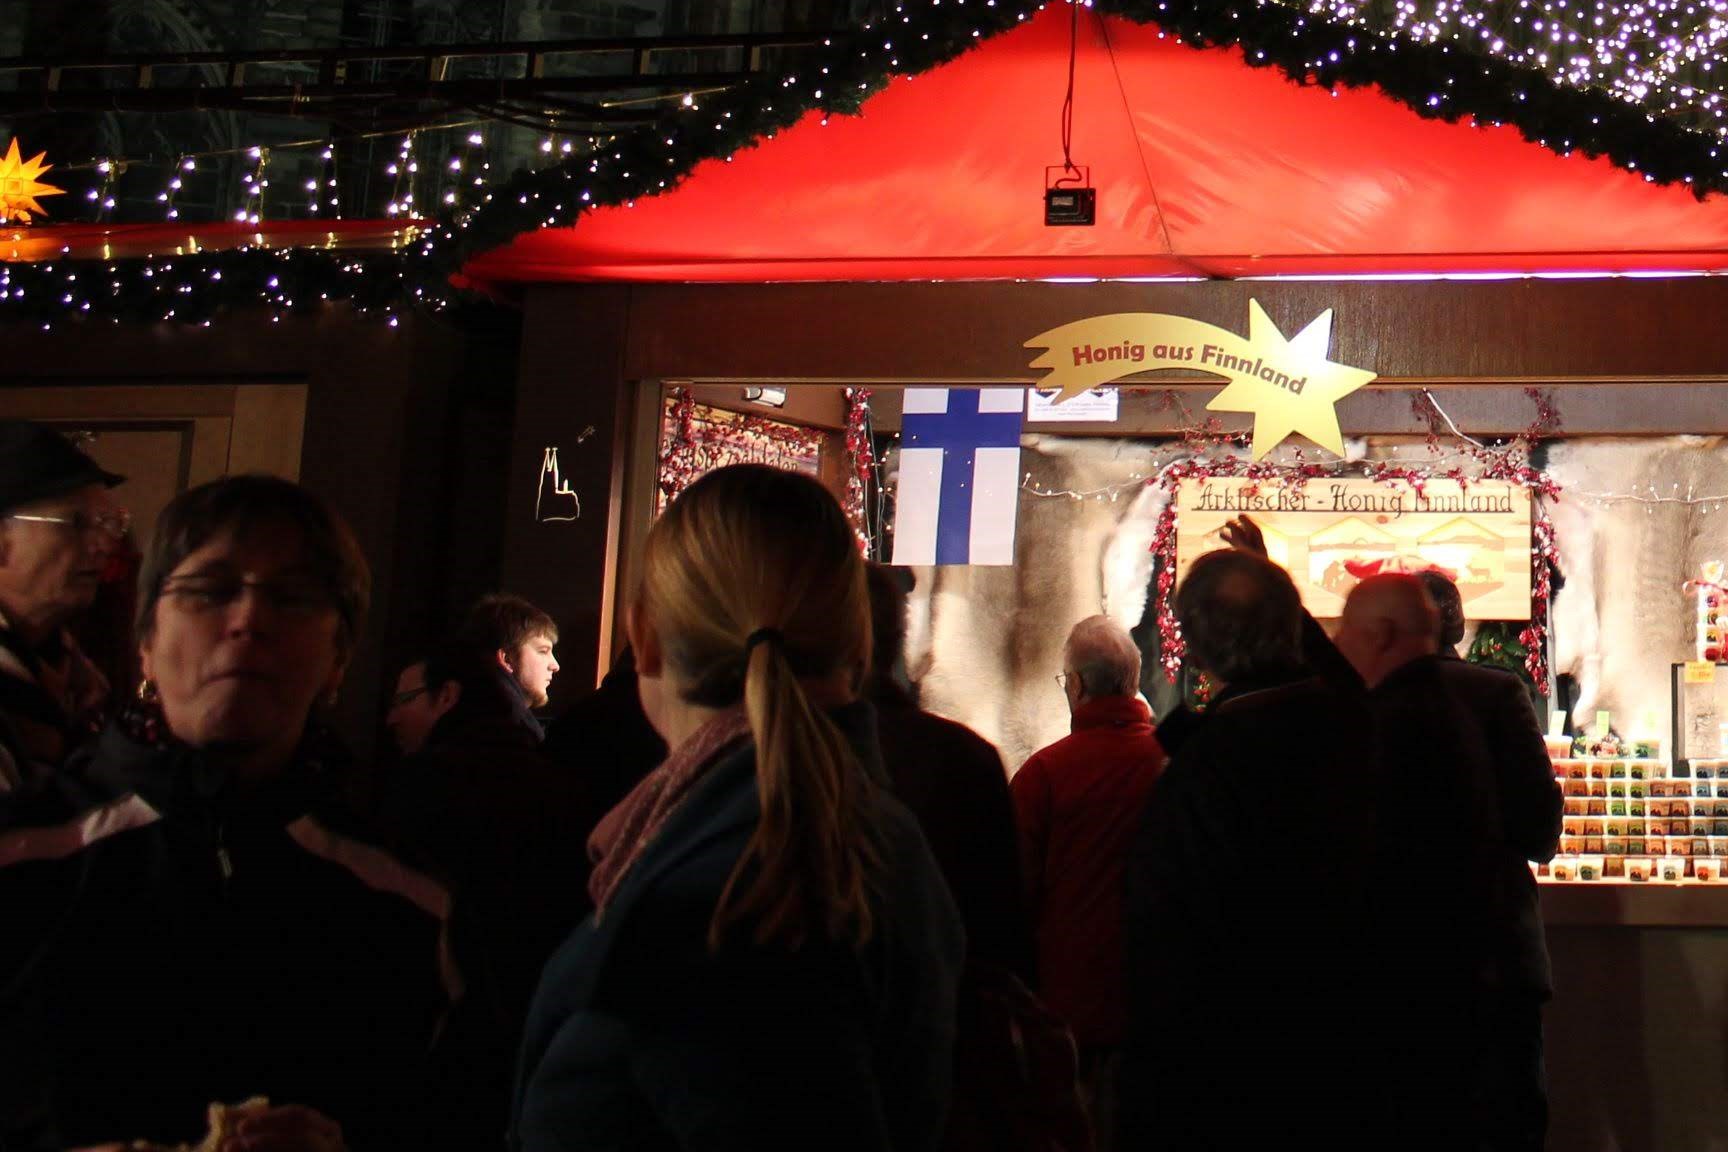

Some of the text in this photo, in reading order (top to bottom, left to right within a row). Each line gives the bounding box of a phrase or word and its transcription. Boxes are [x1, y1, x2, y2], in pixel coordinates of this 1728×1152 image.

[1072, 339, 1308, 396] Honig aus Finnland
[1330, 483, 1402, 519] Honig
